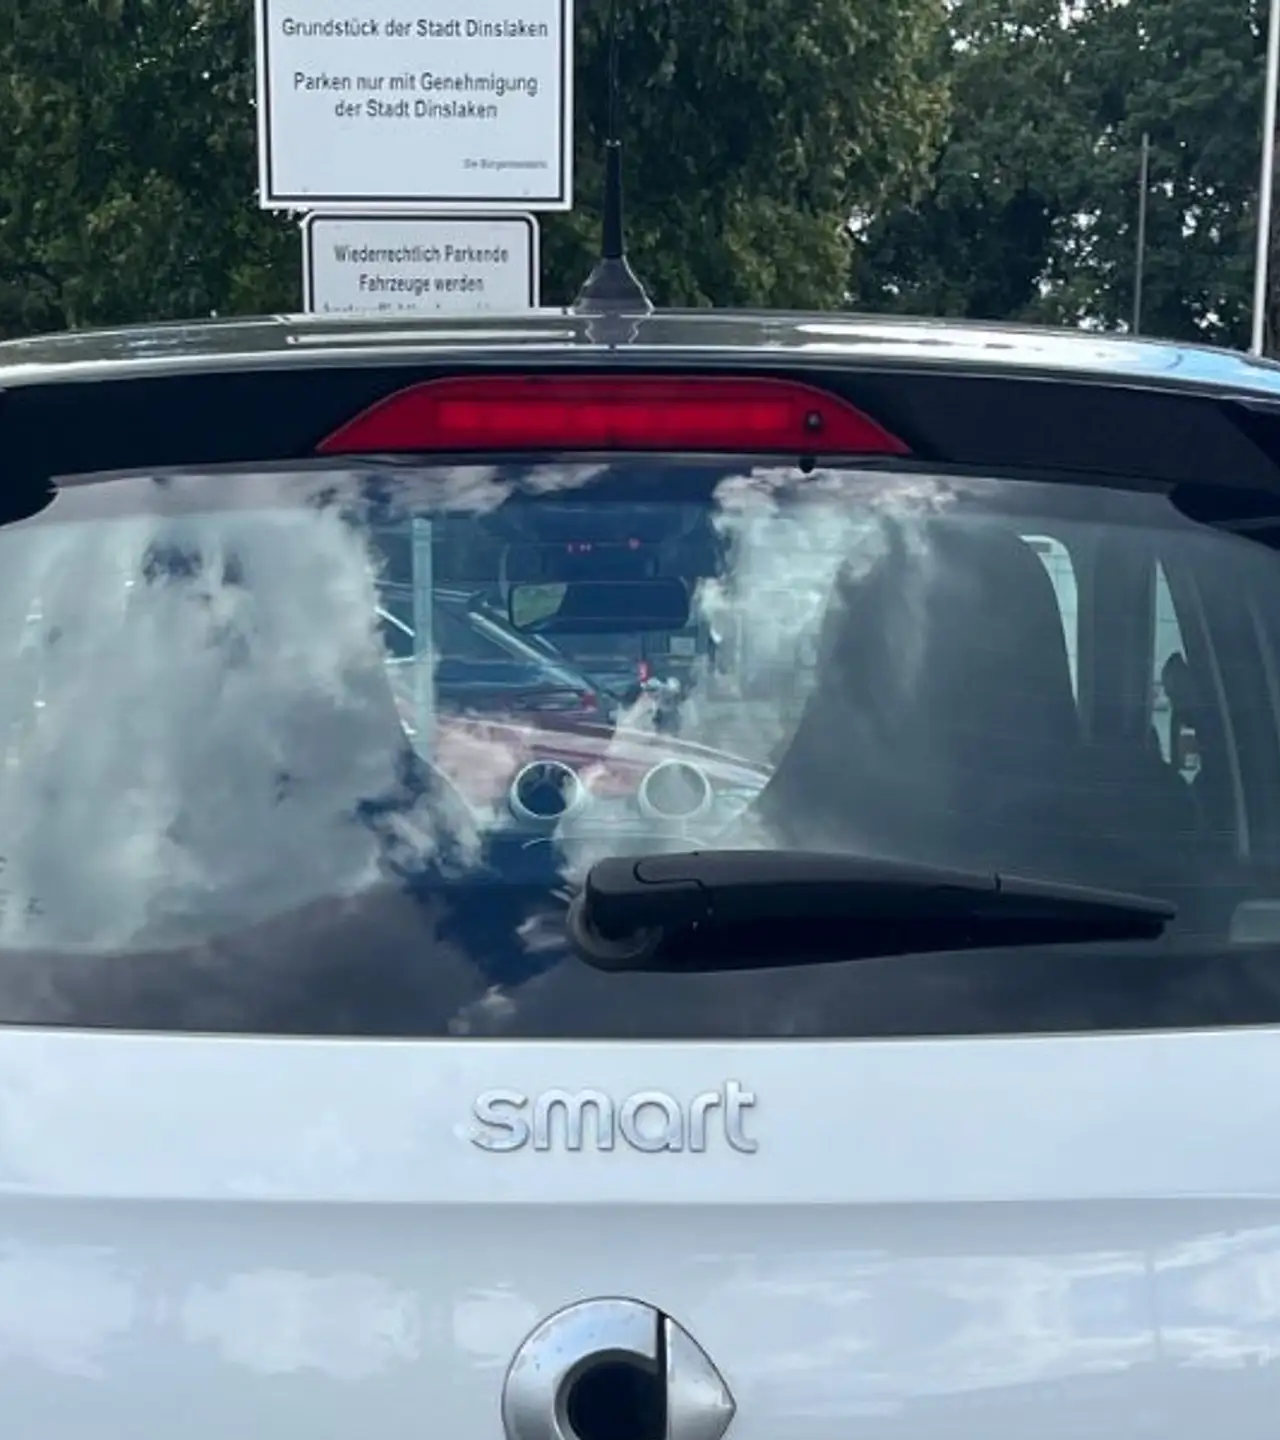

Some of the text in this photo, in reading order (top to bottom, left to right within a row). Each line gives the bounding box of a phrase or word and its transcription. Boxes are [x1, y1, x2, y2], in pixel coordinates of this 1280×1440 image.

[282, 17, 548, 37] Grundstück der Stadt Dinslaken
[294, 71, 538, 97] Parken nur mit Genehmigung
[334, 98, 498, 118] der Stadt Dinslaken
[443, 244, 509, 263] Parkende
[358, 273, 484, 297] Fahrzeuge werden
[470, 1078, 758, 1154] smart
